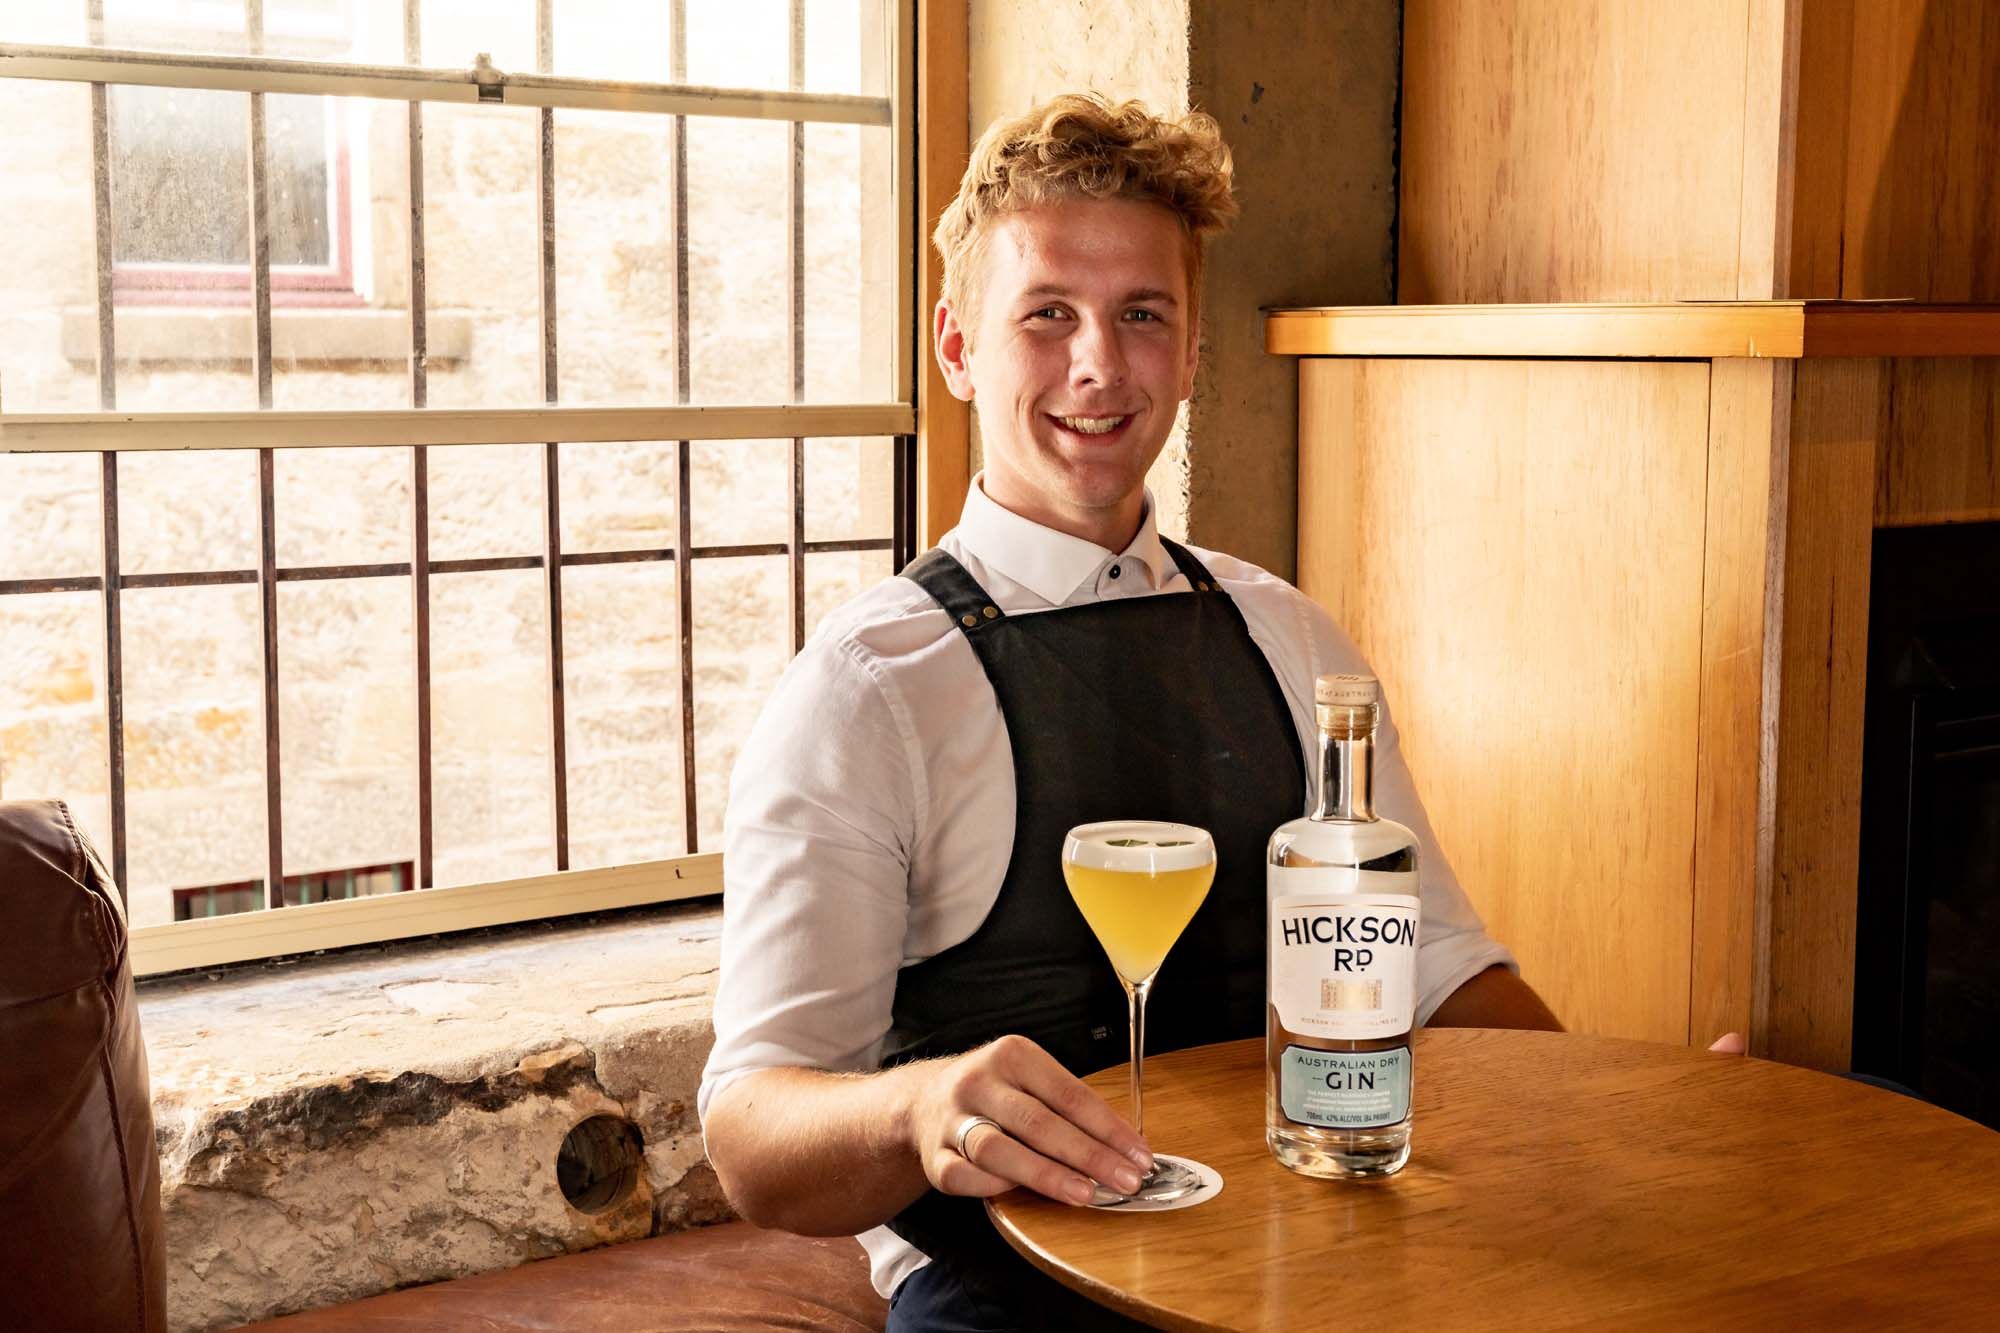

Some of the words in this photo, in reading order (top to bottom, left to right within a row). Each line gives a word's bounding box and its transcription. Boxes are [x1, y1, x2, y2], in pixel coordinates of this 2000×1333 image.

[1282, 916, 1416, 946] HICKSON
[1298, 1056, 1375, 1069] AUSTRALIAN
[1380, 1057, 1399, 1068] DRY
[1326, 1072, 1374, 1090] GIN
